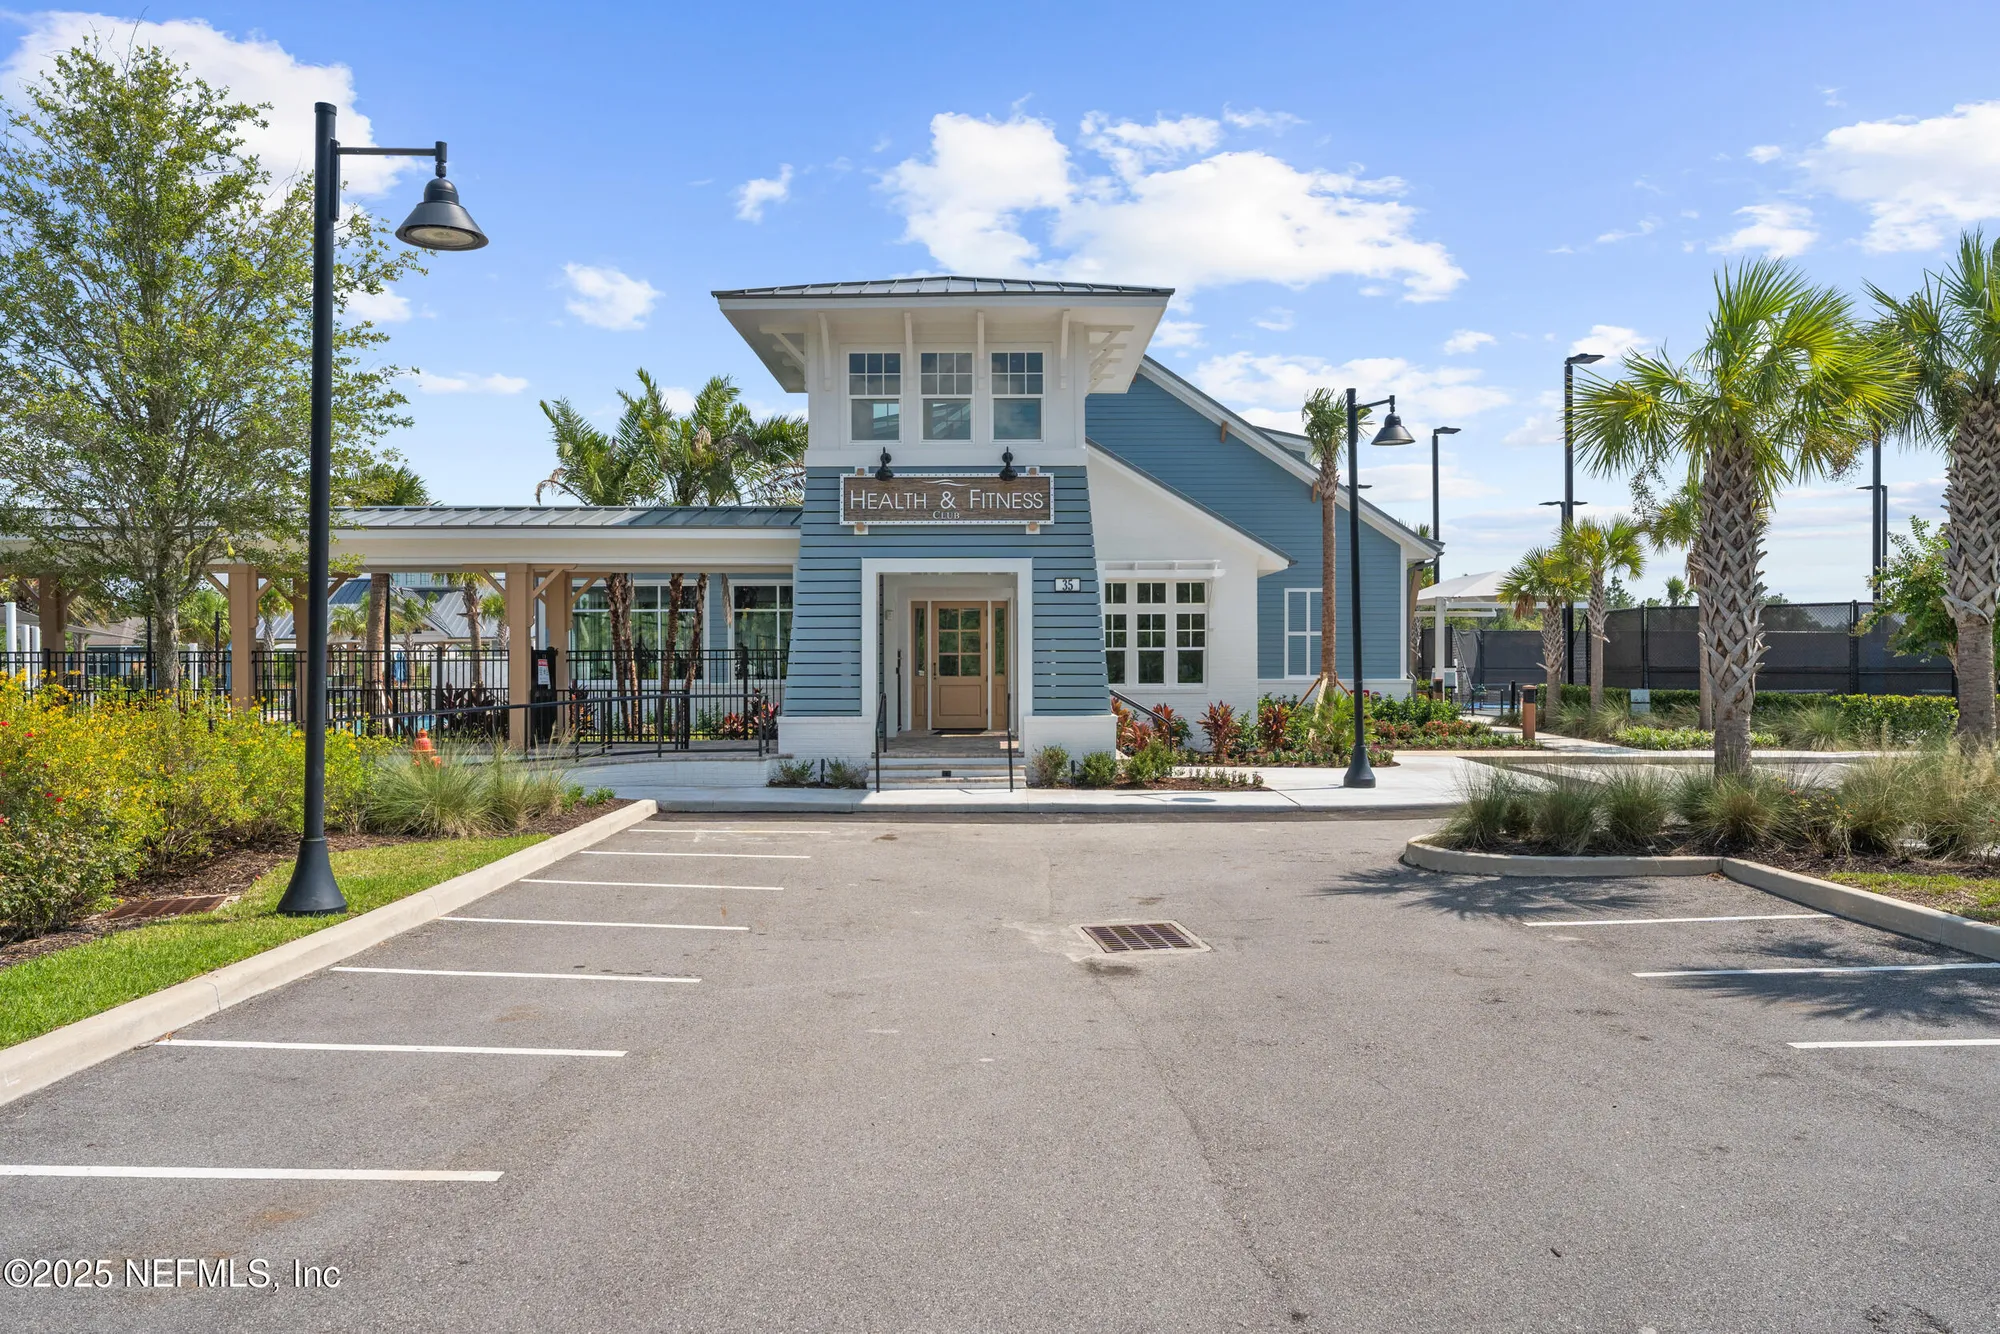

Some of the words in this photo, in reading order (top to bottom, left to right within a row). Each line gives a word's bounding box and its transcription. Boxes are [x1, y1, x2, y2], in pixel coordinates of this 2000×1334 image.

[850, 489, 927, 510] HEALTH
[940, 490, 957, 509] &
[969, 489, 1044, 509] FITNESS
[932, 510, 960, 520] CLUB
[1061, 578, 1074, 591] 35
